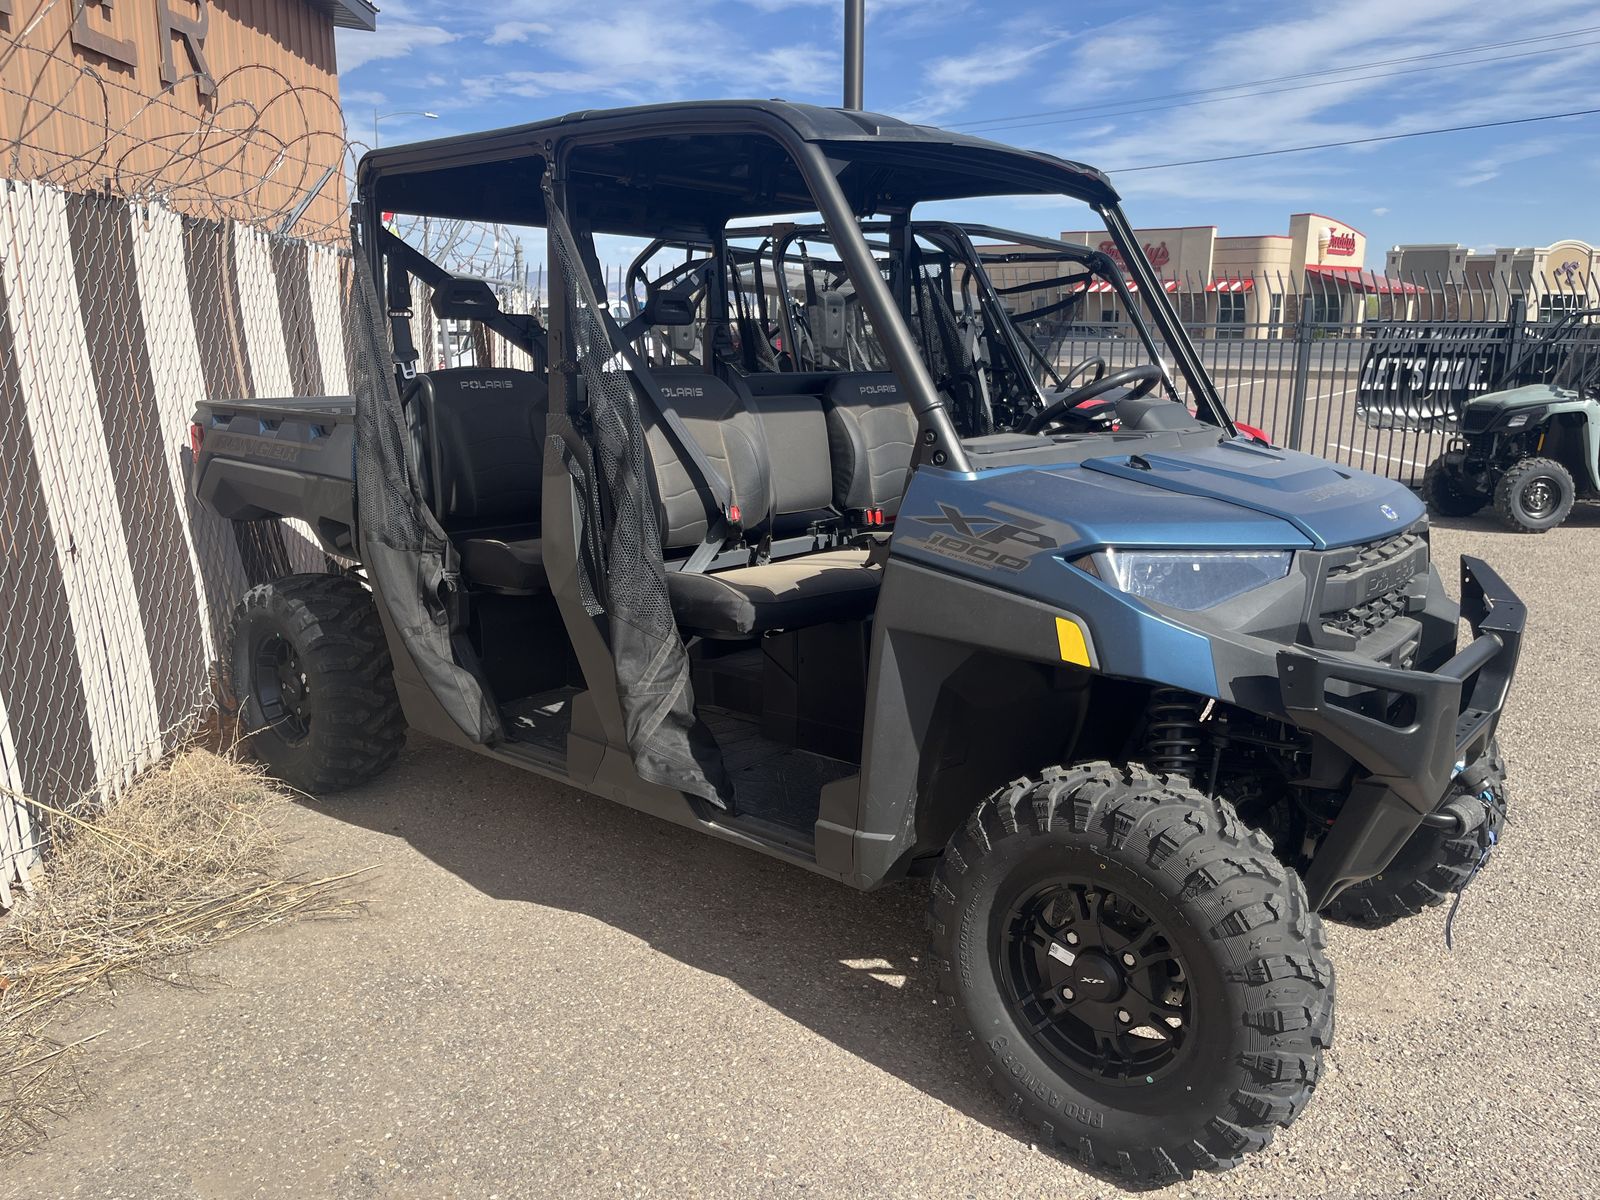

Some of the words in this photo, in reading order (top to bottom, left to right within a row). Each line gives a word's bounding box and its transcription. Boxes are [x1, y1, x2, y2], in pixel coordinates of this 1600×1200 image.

[460, 380, 513, 389] POLARIS
[859, 384, 897, 395] POLARIS
[660, 387, 704, 398] OLARIS
[908, 501, 1060, 549] XP
[926, 533, 1031, 570] 1000
[1080, 976, 1105, 984] XP
[1063, 1102, 1104, 1128] PRO
